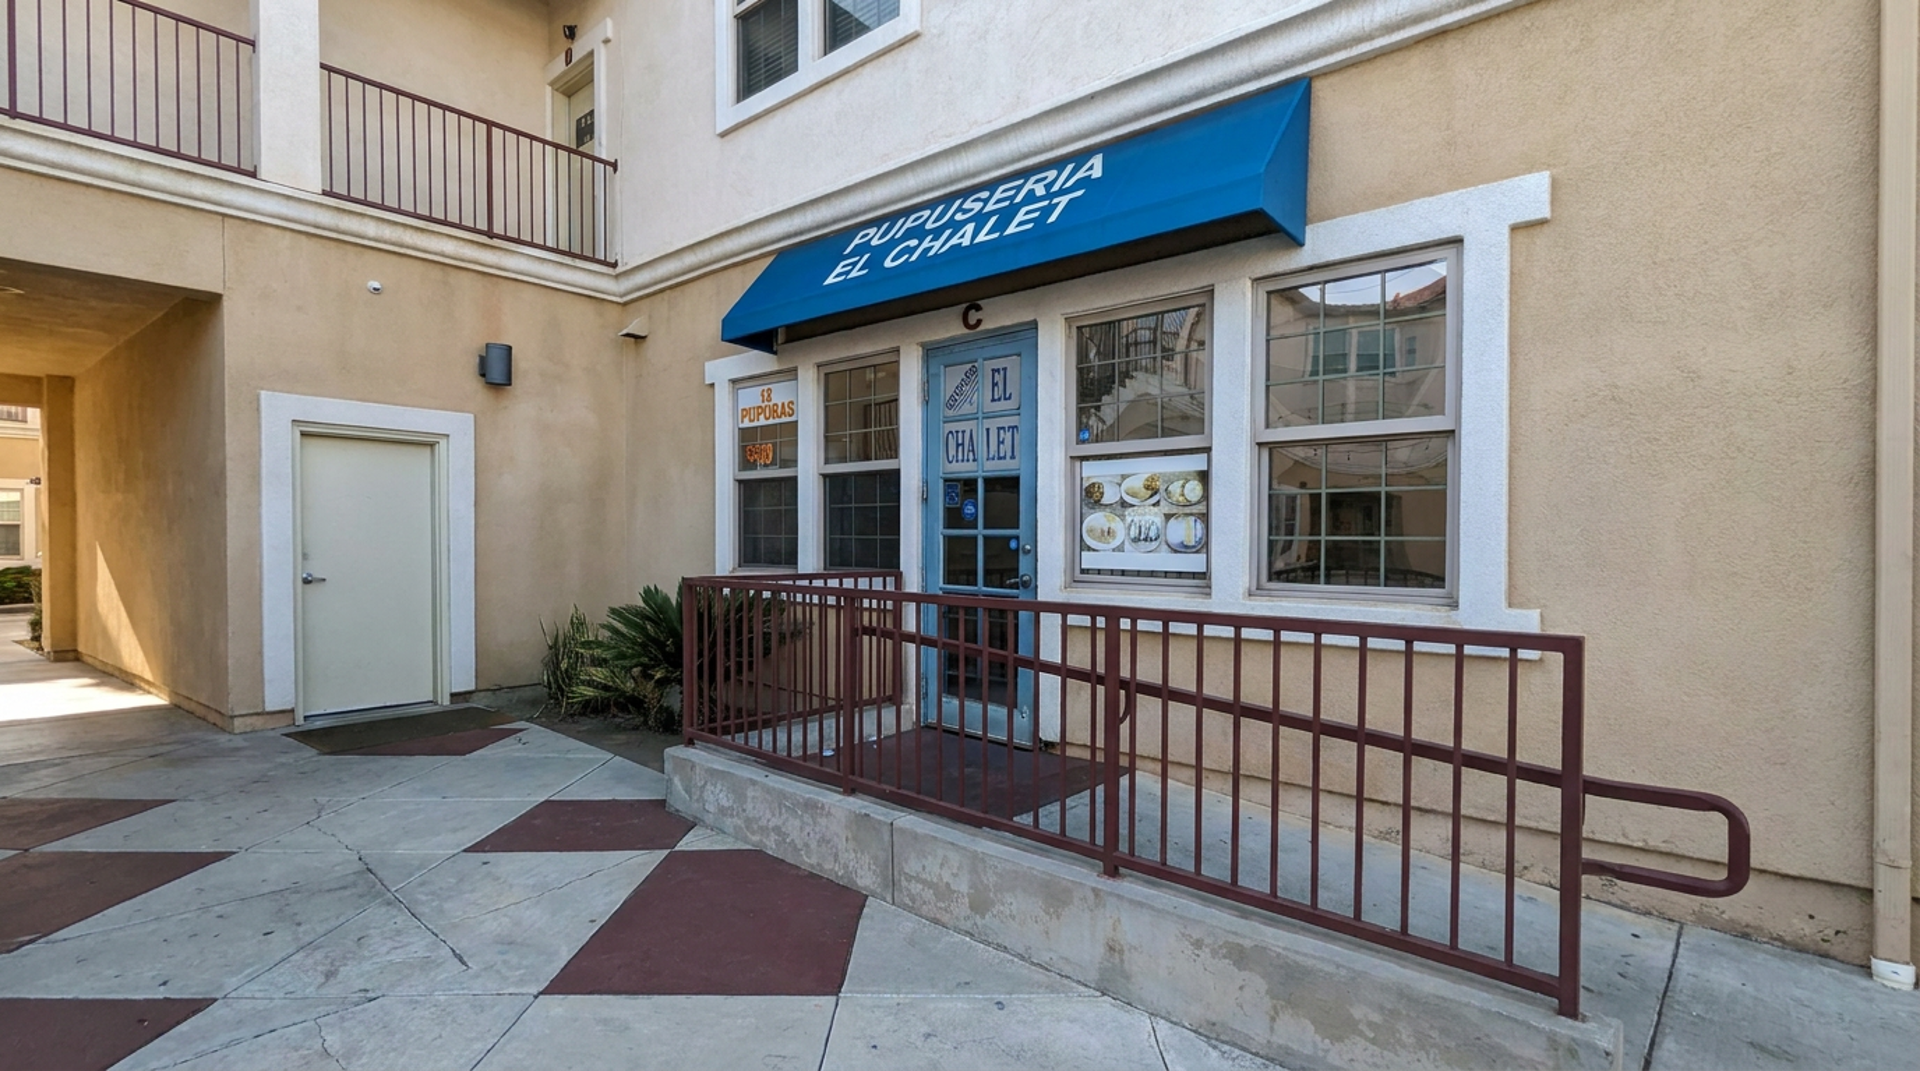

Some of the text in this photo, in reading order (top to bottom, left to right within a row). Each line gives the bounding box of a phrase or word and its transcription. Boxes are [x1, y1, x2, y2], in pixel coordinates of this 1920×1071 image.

[822, 188, 1086, 287] EL CHALET
[842, 153, 1104, 255] PUPUSERIA
[962, 302, 983, 331] C
[990, 366, 1012, 403] EL
